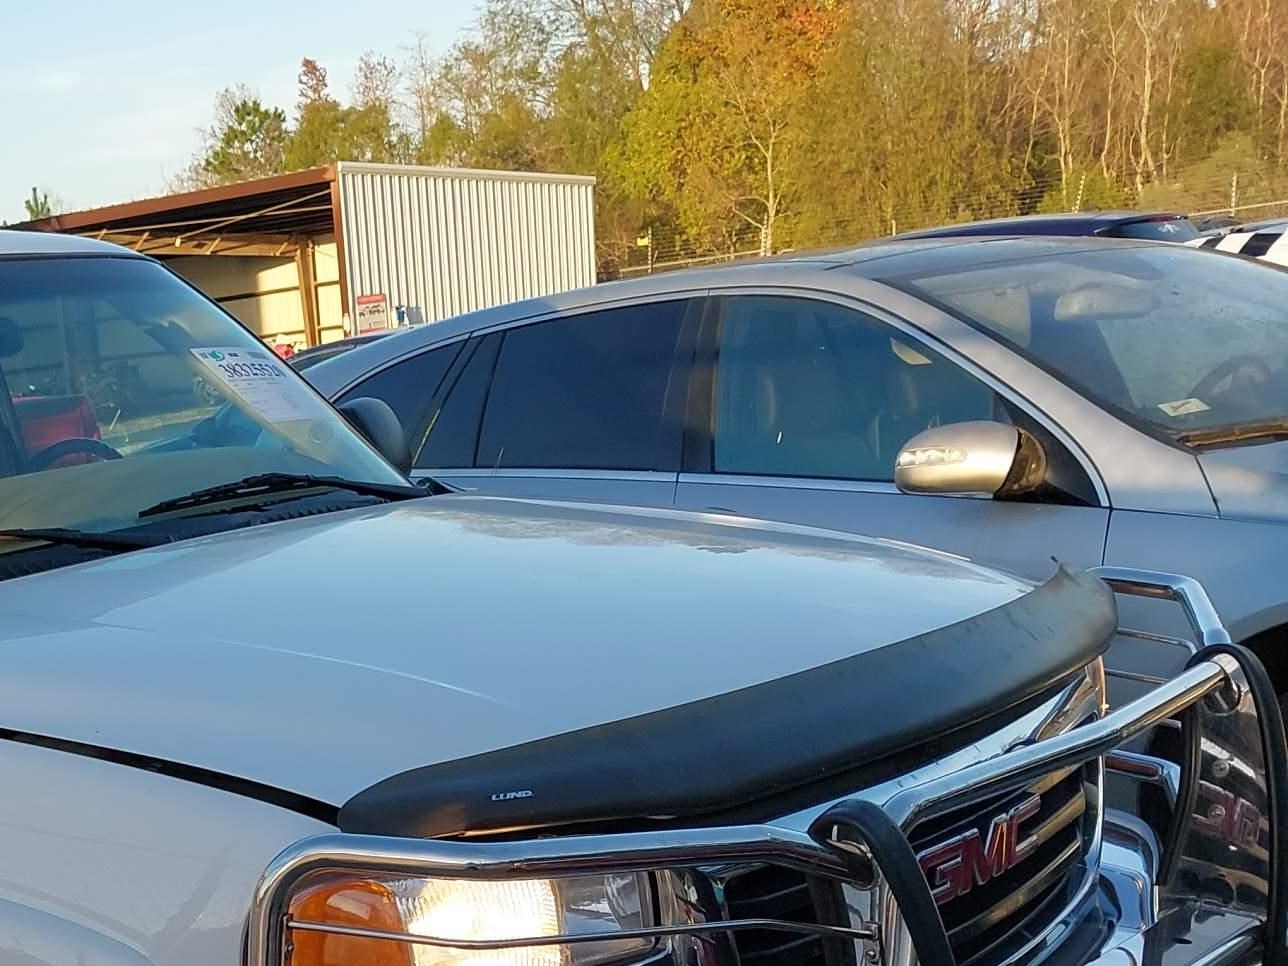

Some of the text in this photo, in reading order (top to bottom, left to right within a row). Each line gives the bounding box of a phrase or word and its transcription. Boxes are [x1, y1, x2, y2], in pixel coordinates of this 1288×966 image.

[218, 363, 287, 378] 38325520
[492, 790, 532, 801] LUND
[916, 792, 1041, 906] GMC
